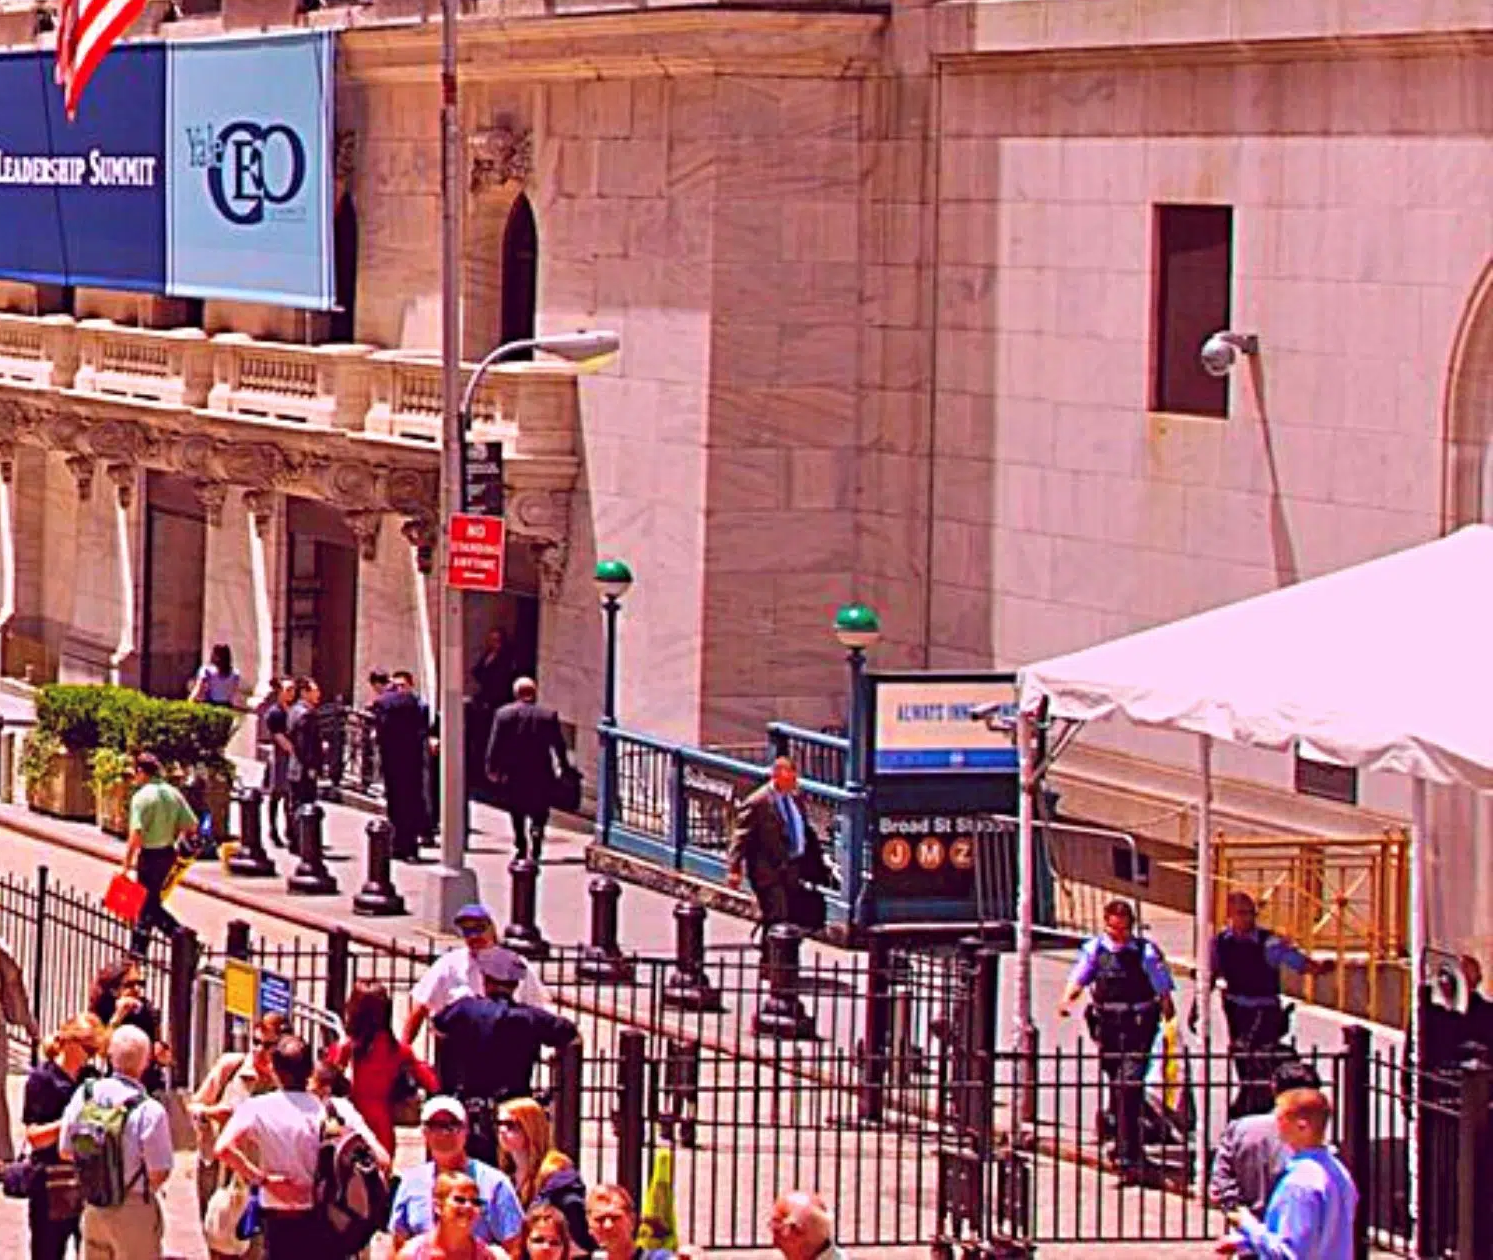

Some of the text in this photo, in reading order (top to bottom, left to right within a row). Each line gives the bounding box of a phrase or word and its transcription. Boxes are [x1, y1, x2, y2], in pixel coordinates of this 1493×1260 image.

[466, 523, 486, 539] NO
[879, 816, 929, 835] Broad
[932, 816, 952, 833] St
